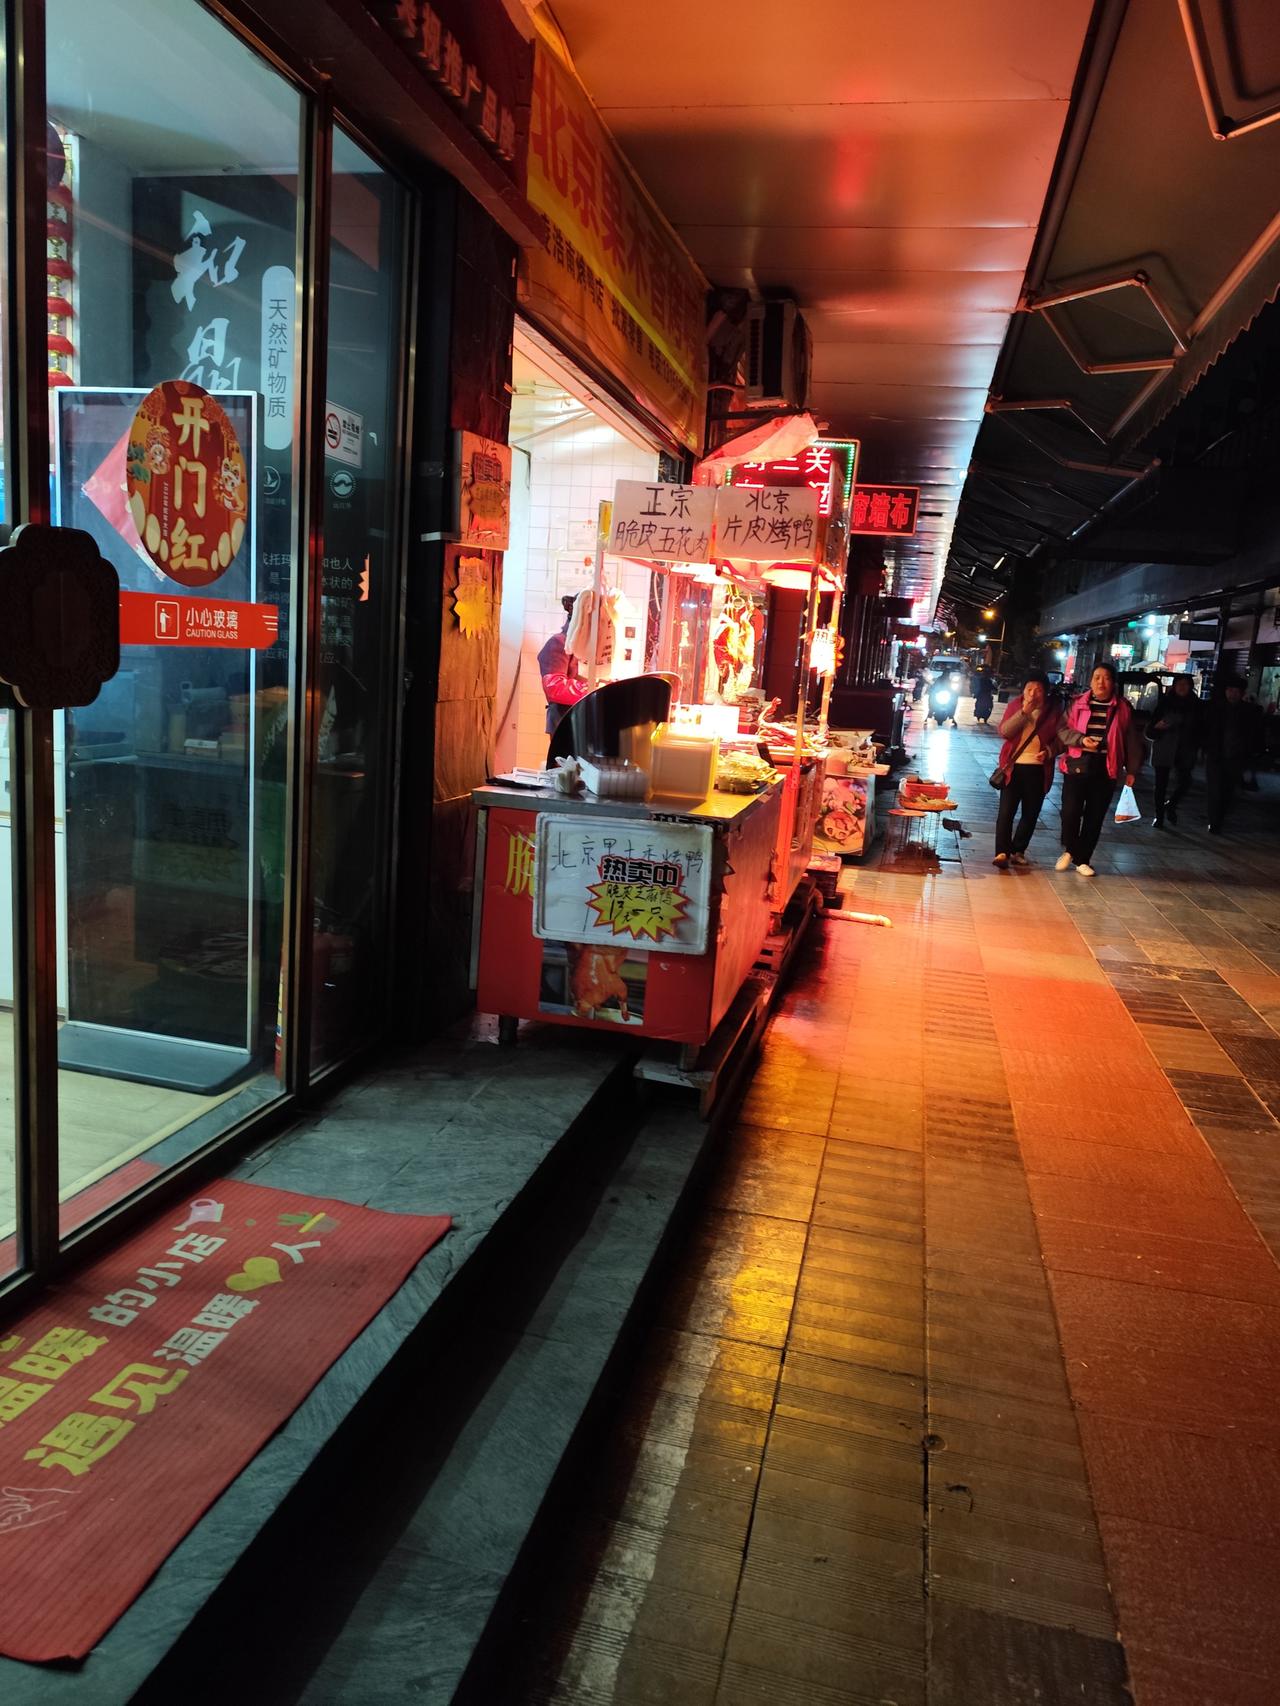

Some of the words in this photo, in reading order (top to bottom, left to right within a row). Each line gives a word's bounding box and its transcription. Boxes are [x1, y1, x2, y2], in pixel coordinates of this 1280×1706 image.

[267, 298, 288, 418] 天然矿物质
[171, 396, 210, 572] 开门红
[639, 487, 694, 518] 正宗
[745, 489, 790, 514] 北京
[615, 521, 710, 558] 脆皮五花肉
[723, 514, 814, 550] 片皮烤鸭
[186, 607, 239, 630] 小心玻璃
[186, 628, 216, 638] CAUTION
[217, 630, 239, 640] GLASS
[603, 858, 679, 887] 热卖中
[23, 1292, 261, 1477] 遇见温暖
[271, 1240, 321, 1264] 人
